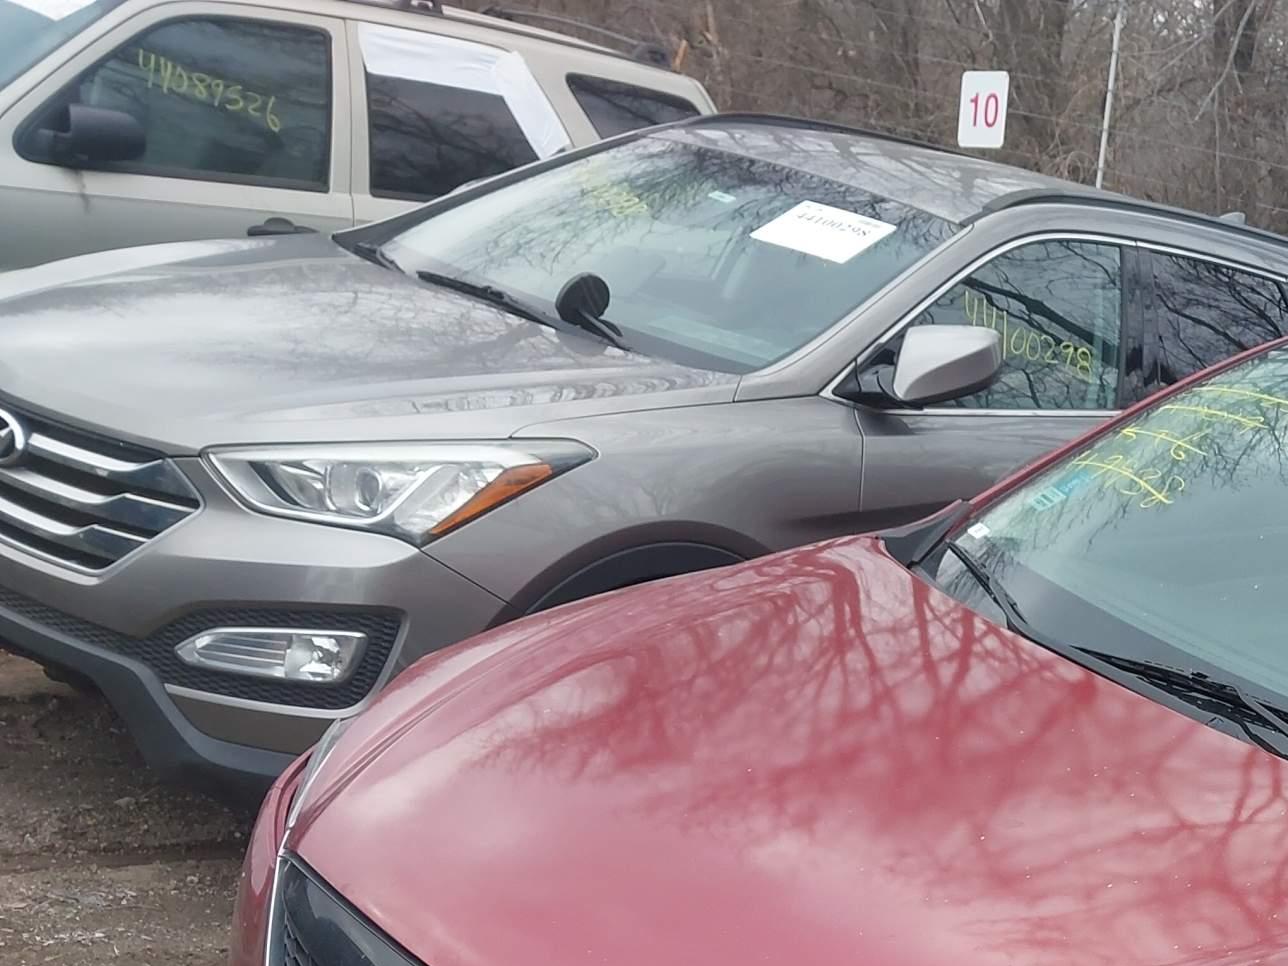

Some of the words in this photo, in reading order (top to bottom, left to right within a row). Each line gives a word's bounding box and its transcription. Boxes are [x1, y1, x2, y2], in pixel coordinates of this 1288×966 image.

[138, 48, 281, 133] 44089526
[970, 91, 999, 128] 10
[964, 289, 1093, 384] 44100298
